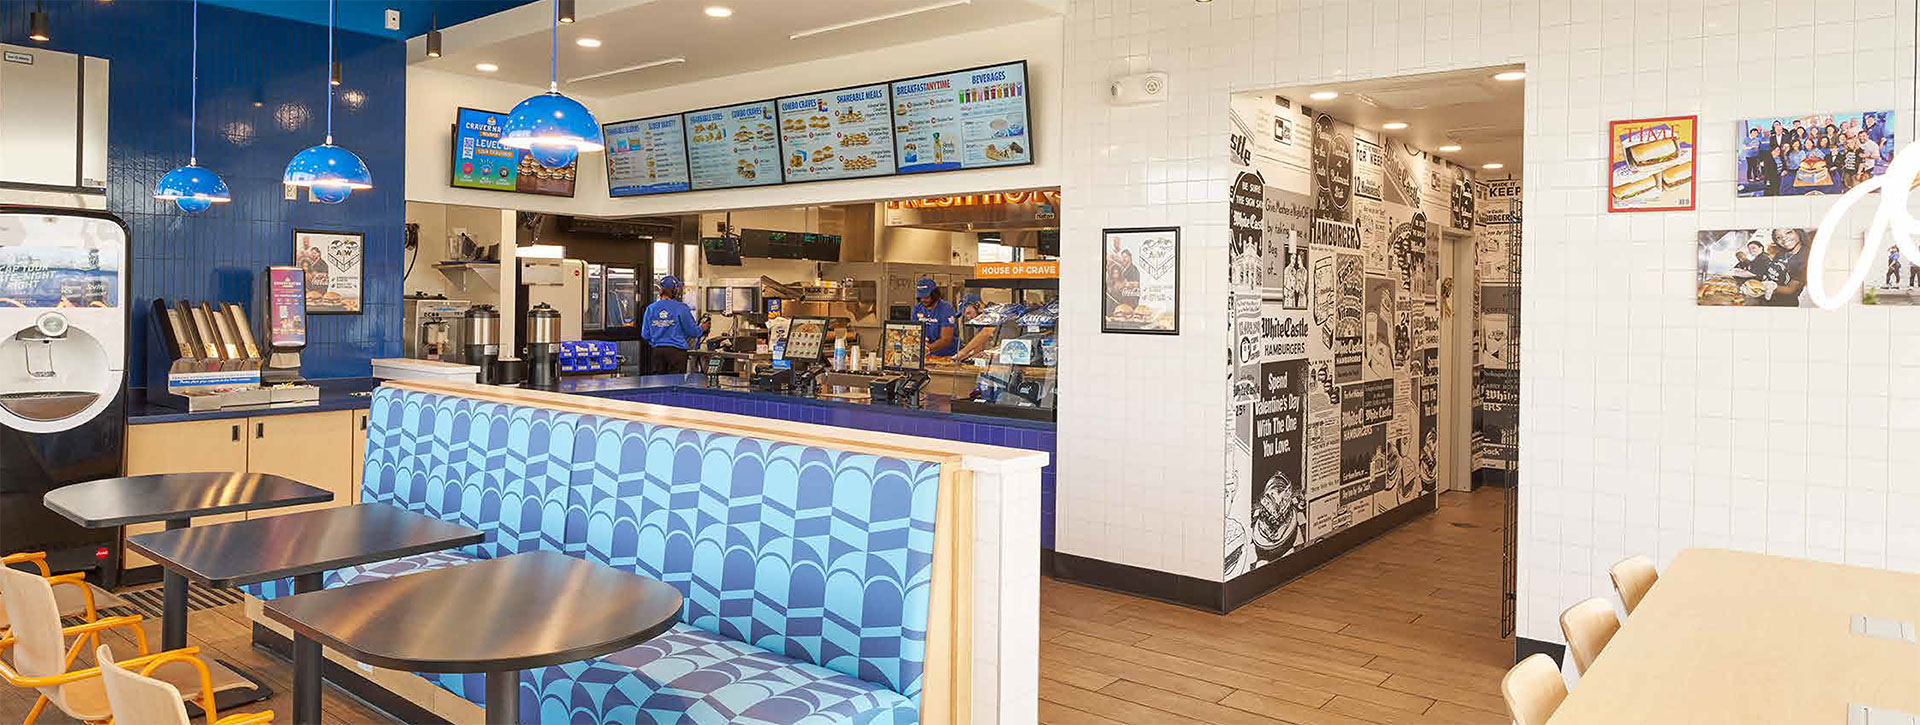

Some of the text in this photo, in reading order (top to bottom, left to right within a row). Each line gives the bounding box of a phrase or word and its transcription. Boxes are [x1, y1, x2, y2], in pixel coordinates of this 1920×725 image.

[972, 71, 1006, 84] BEVERAGES
[836, 89, 882, 103] SHAREABLE MEALS
[782, 101, 799, 111] COMBO
[475, 138, 501, 149] LEVEL
[1310, 208, 1361, 250] HAMBURGERS
[982, 266, 1056, 275] HOUSE OF CRAVE
[1400, 311, 1410, 326] 24
[1261, 317, 1284, 340] White
[1284, 317, 1309, 338] Castle
[1264, 343, 1306, 356] HAMBURGERS
[1268, 371, 1288, 393] Spend
[1255, 393, 1300, 415] Valentine's Day
[1256, 414, 1298, 438] With The One
[1262, 437, 1291, 458] You Love.
